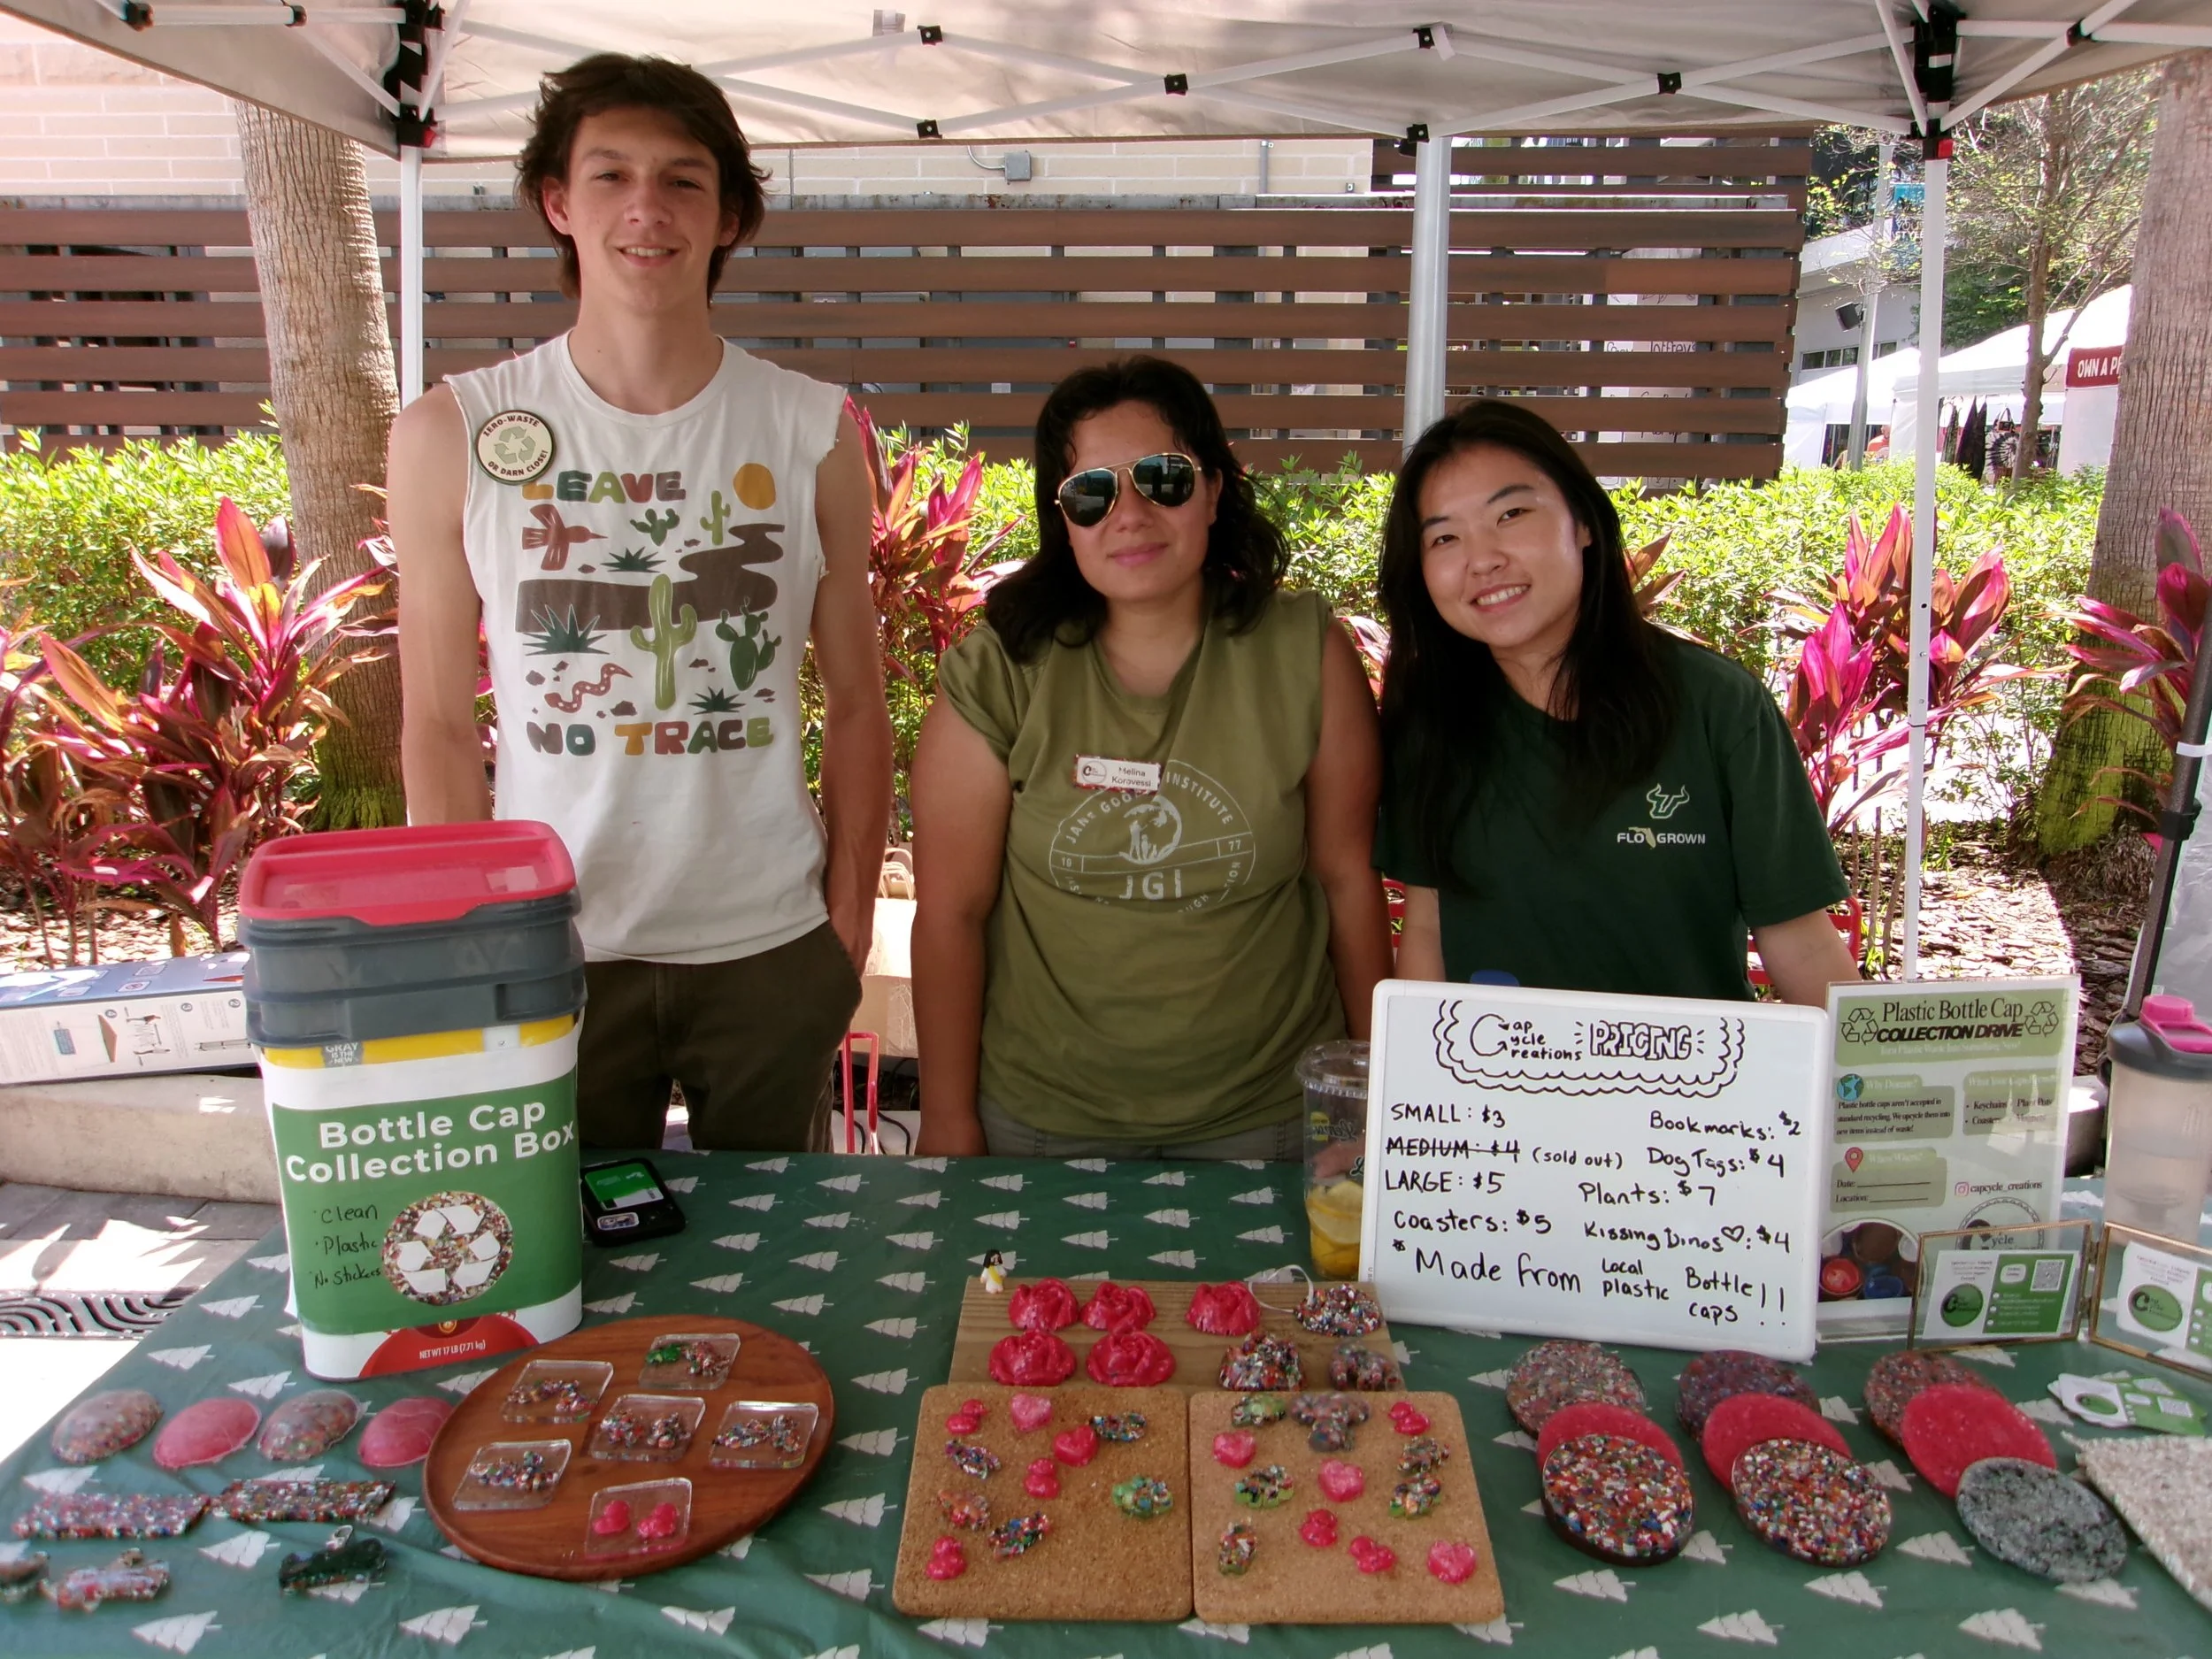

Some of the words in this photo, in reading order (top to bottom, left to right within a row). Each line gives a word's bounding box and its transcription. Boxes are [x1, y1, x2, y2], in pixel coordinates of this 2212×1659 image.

[2078, 358, 2100, 379] OWN
[2100, 357, 2108, 376] A
[483, 415, 540, 437] ZERO-WASTE
[488, 461, 499, 472] OR
[500, 468, 525, 477] DARN
[526, 449, 549, 472] CLOSE!
[526, 720, 595, 755] NO
[614, 716, 774, 755] TRACE
[1066, 812, 1096, 845] JANE
[1165, 771, 1233, 825] INSTITUTE
[1062, 856, 1072, 867] 19
[1118, 869, 1183, 901] JGI
[1881, 1000, 1935, 1023] Plastic
[1938, 997, 1988, 1021] Bottle
[1990, 997, 2023, 1023] Cap
[1589, 1020, 1694, 1061] PRICING
[1877, 1025, 1973, 1043] COLLECTION
[1973, 1023, 2025, 1040] DRIVE
[1390, 1103, 1473, 1124] SMALL:
[1482, 1104, 1506, 1128] $3
[1973, 1099, 2008, 1111] Keychains
[319, 1108, 453, 1149] Bottle
[469, 1101, 547, 1135] Cap
[1649, 1110, 1776, 1141] Bookmarks:
[1779, 1110, 1802, 1136] $2
[1972, 1116, 2001, 1125] Coaster
[285, 1141, 499, 1185] Collection
[514, 1119, 575, 1160] Box
[1386, 1136, 1481, 1159] MEDIUM:
[1532, 1145, 1578, 1165] (sold
[1585, 1151, 1624, 1171] out)
[1385, 1169, 1464, 1194] LARGE:
[1472, 1170, 1505, 1194] $5
[1578, 1182, 1670, 1207] Plants:
[1677, 1179, 1717, 1207] $7
[1836, 1179, 1855, 1188] Date:
[1970, 1179, 2043, 1195] capcycle_creations
[1835, 1193, 1869, 1203] Location:
[321, 1204, 379, 1225] Clean
[1394, 1210, 1509, 1233] Coasters:
[1517, 1209, 1553, 1235] $5
[1583, 1221, 1661, 1252] Kissing
[1756, 1225, 1792, 1254] $4
[1415, 1248, 1502, 1282] Made
[1517, 1252, 1582, 1294] from
[1601, 1257, 1644, 1277] Local
[1601, 1277, 1671, 1301] plastic
[1688, 1302, 1740, 1325] caps
[419, 1349, 432, 1359] NET
[432, 1348, 442, 1358] WT
[443, 1346, 450, 1356] 17
[451, 1344, 458, 1354] LB
[459, 1341, 474, 1354] (7.71
